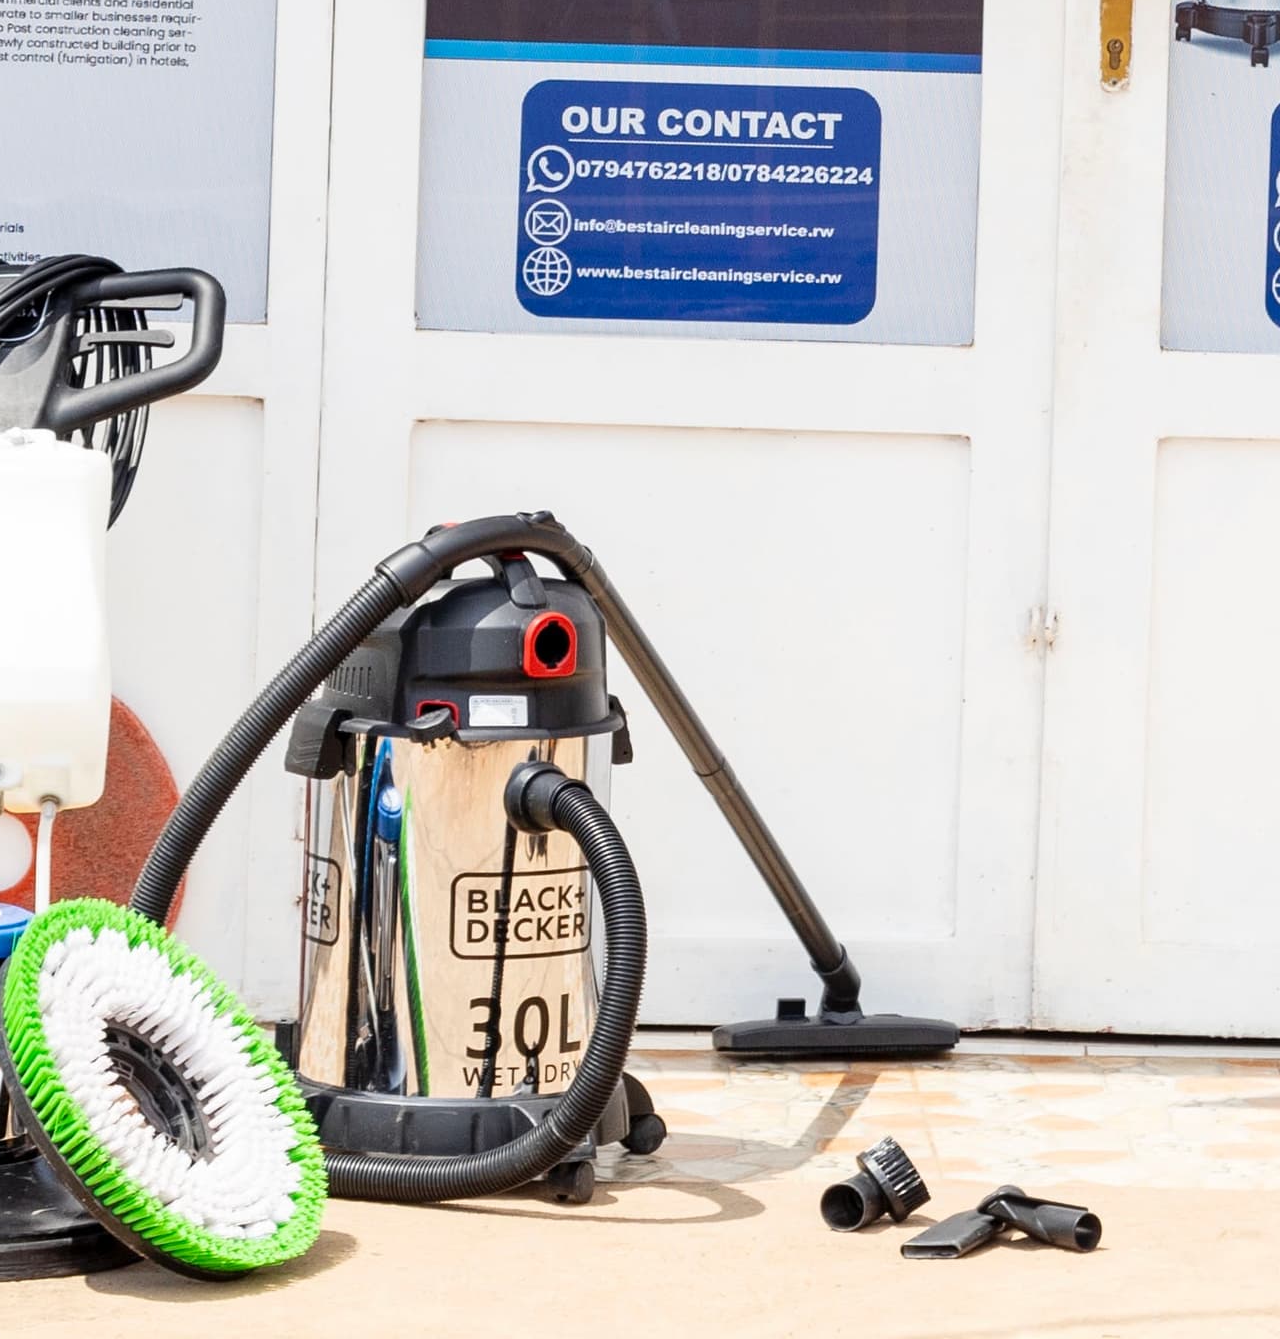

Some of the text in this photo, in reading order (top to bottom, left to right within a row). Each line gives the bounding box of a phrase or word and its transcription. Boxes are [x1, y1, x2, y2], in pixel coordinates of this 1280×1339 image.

[561, 105, 843, 140] OUR CONTACT
[575, 159, 874, 185] 0794762218/0784226224
[573, 218, 835, 239] info@bestaircleaningservice.rw
[576, 265, 842, 285] www.bestaircleaningservice.rw
[467, 884, 585, 914] BLACK+
[467, 912, 585, 944] DECKER
[466, 993, 581, 1060] 30L
